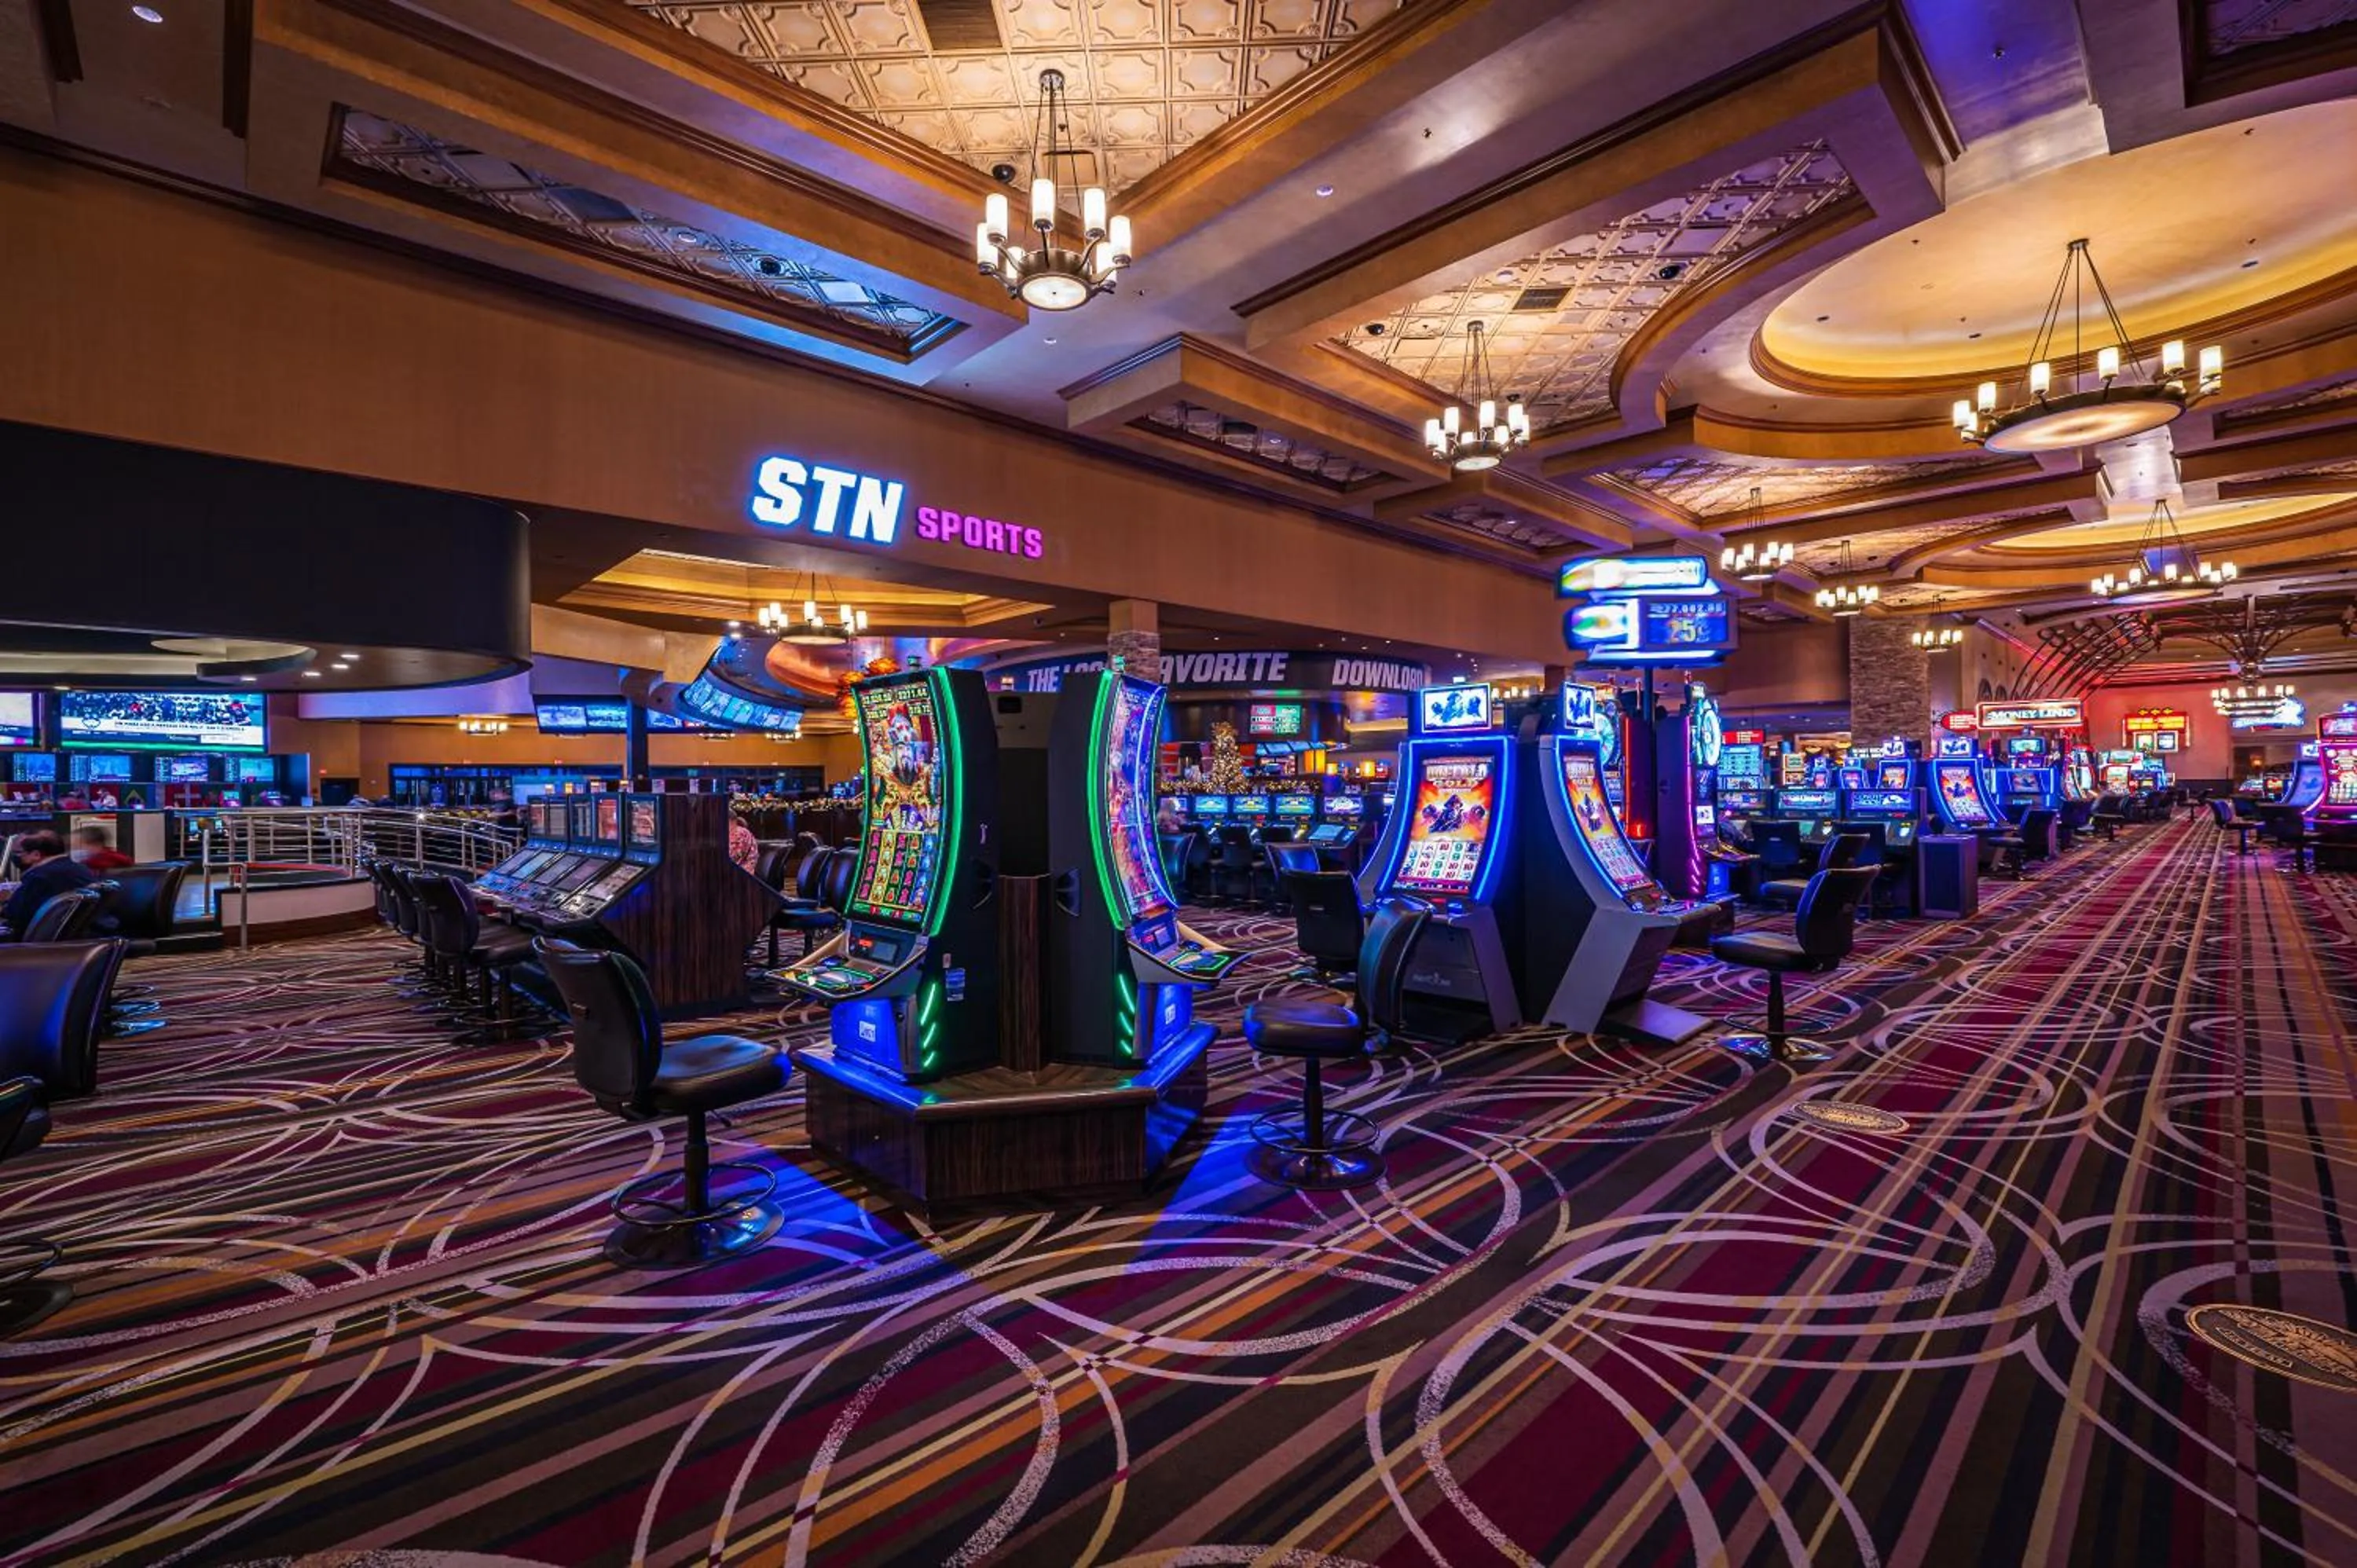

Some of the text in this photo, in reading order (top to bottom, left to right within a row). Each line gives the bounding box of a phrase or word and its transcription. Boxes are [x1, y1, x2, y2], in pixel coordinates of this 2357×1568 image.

[752, 456, 1043, 559] STN SPORTS
[1028, 666, 1060, 692] THE
[1159, 653, 1289, 684] AVORITE
[1988, 710, 2038, 721] MONEY
